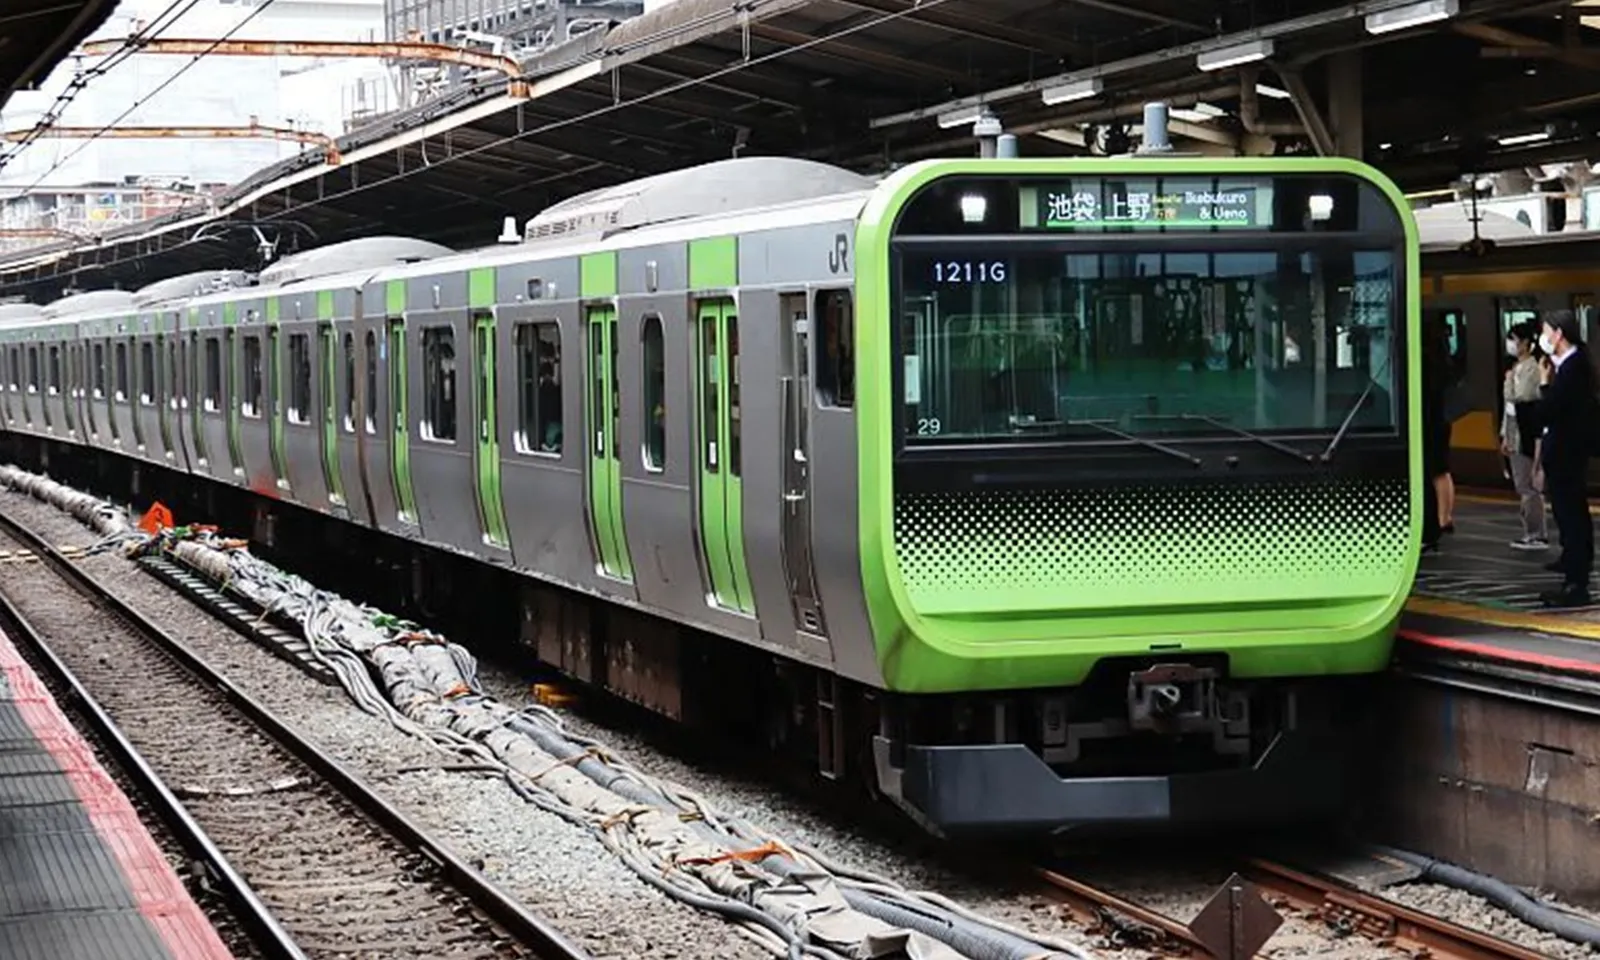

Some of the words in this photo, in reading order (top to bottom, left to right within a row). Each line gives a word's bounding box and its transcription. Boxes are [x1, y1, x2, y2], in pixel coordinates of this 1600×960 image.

[1200, 206, 1211, 219] &
[1214, 206, 1247, 219] Ueno
[828, 234, 849, 274] JR
[934, 261, 1006, 282] 1211G
[917, 418, 941, 435] 29
